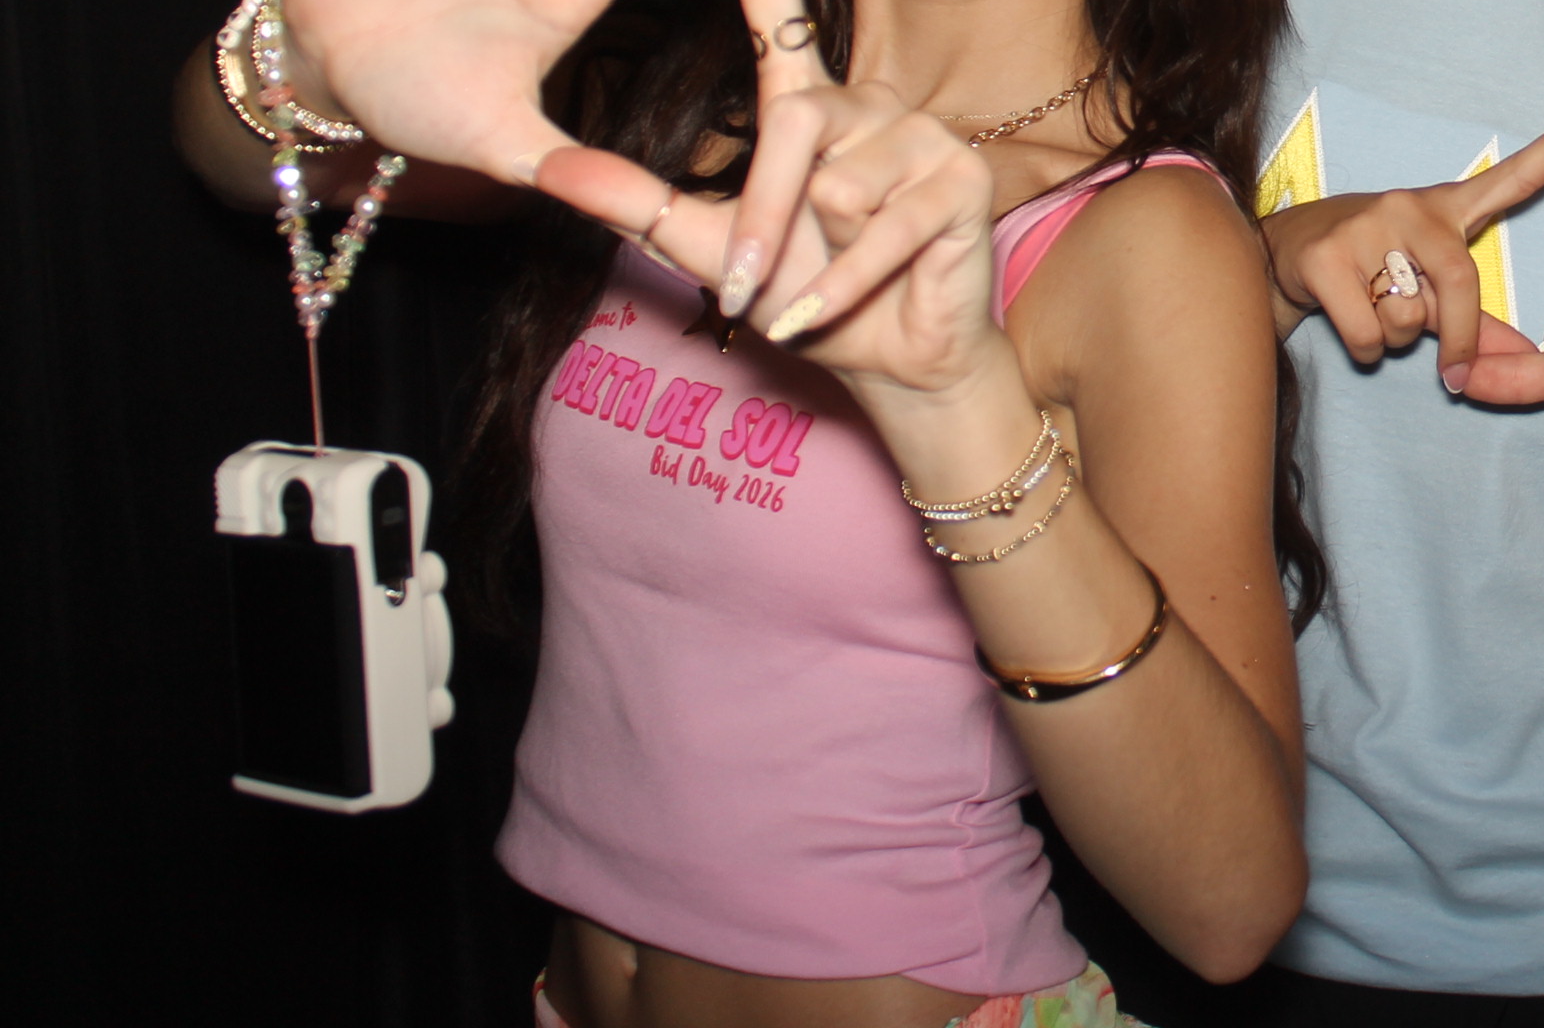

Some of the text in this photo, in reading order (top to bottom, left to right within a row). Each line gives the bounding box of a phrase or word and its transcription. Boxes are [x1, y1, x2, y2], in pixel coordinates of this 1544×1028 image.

[619, 301, 639, 331] to
[552, 339, 814, 477] DELTA DEL SOL
[650, 445, 786, 513] Bid Day 2026
